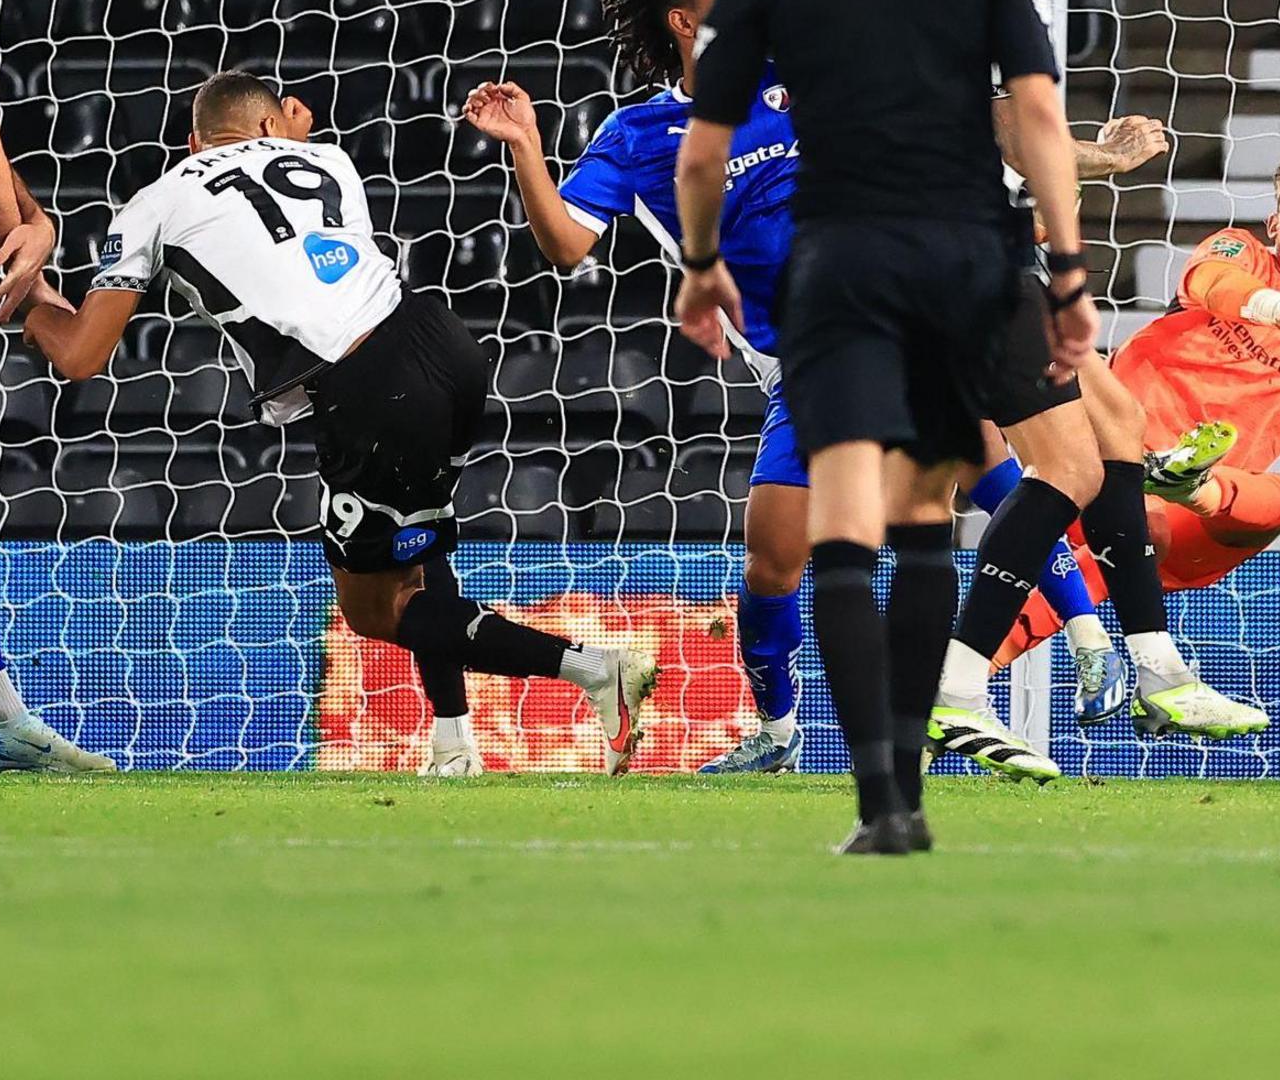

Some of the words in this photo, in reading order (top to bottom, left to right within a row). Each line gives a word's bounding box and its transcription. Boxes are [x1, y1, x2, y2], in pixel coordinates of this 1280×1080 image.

[180, 139, 325, 179] JACKS
[203, 154, 345, 245] 19
[310, 245, 350, 268] hsg
[1207, 316, 1244, 360] Valves
[396, 532, 428, 552] hsg
